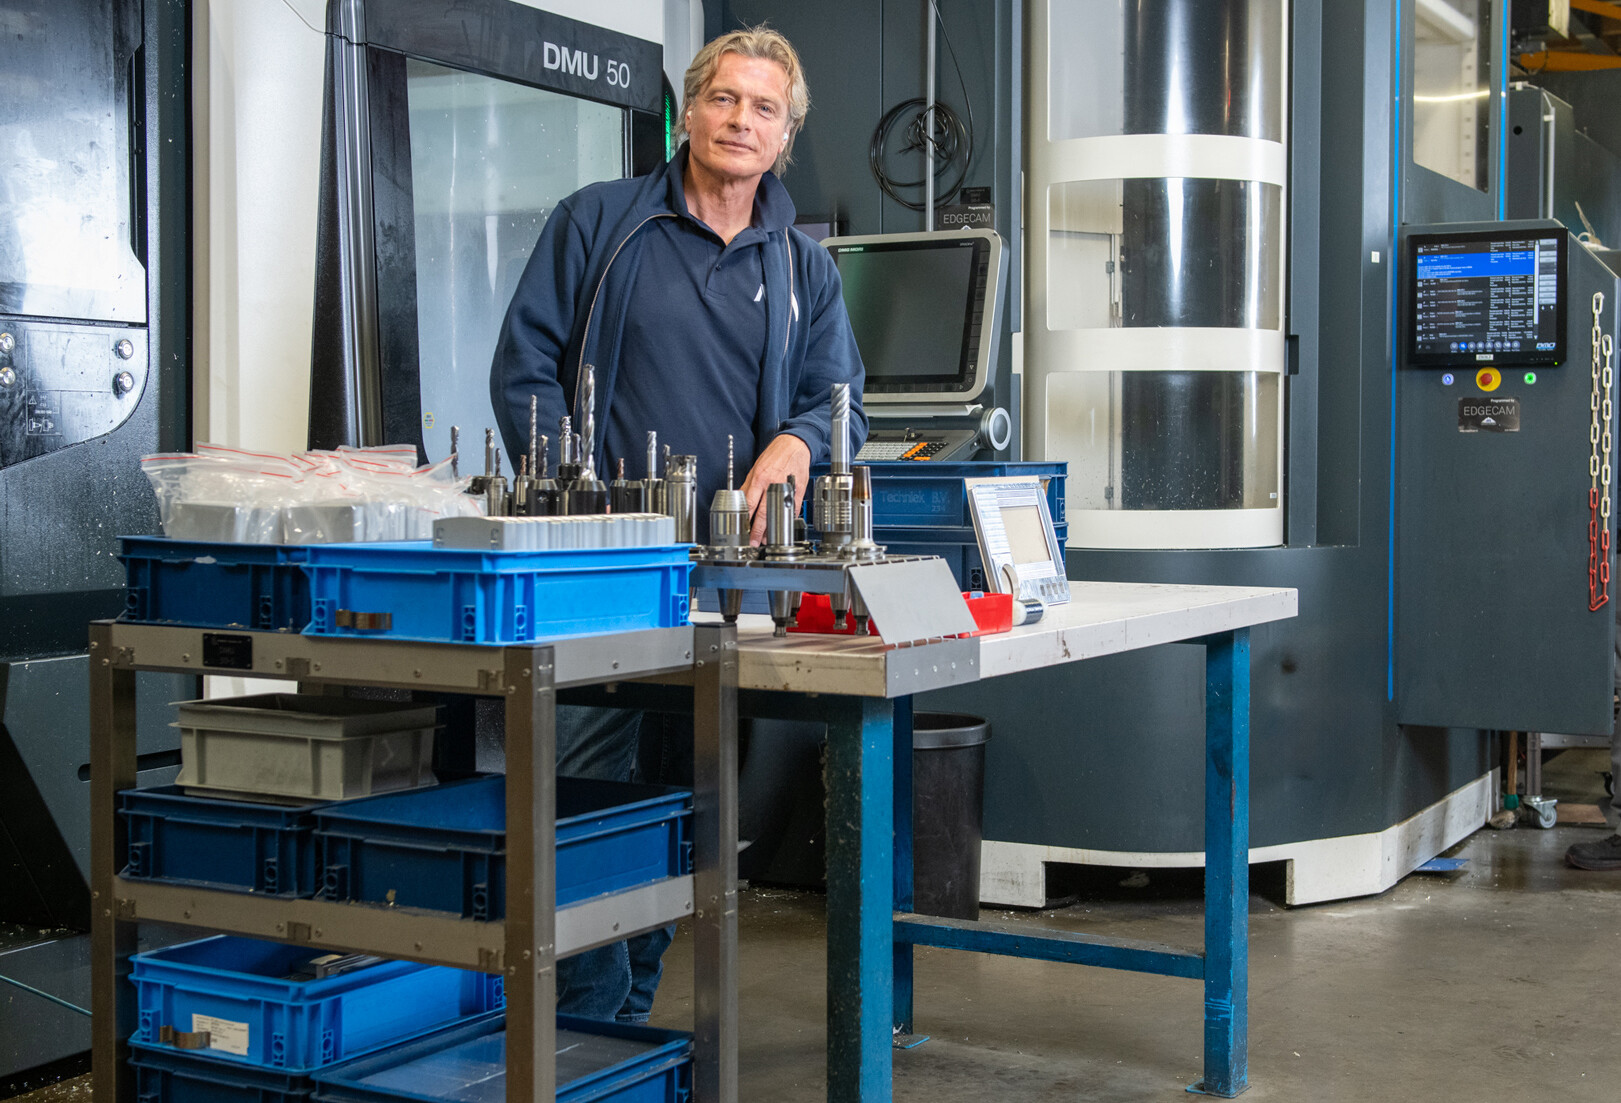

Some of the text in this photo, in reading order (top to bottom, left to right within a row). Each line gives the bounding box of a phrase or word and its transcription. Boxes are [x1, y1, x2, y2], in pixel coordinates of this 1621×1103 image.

[543, 41, 630, 89] DMU 50
[943, 213, 991, 224] EDGECAM
[1463, 405, 1516, 416] EDGECAM
[879, 490, 926, 504] Techniek
